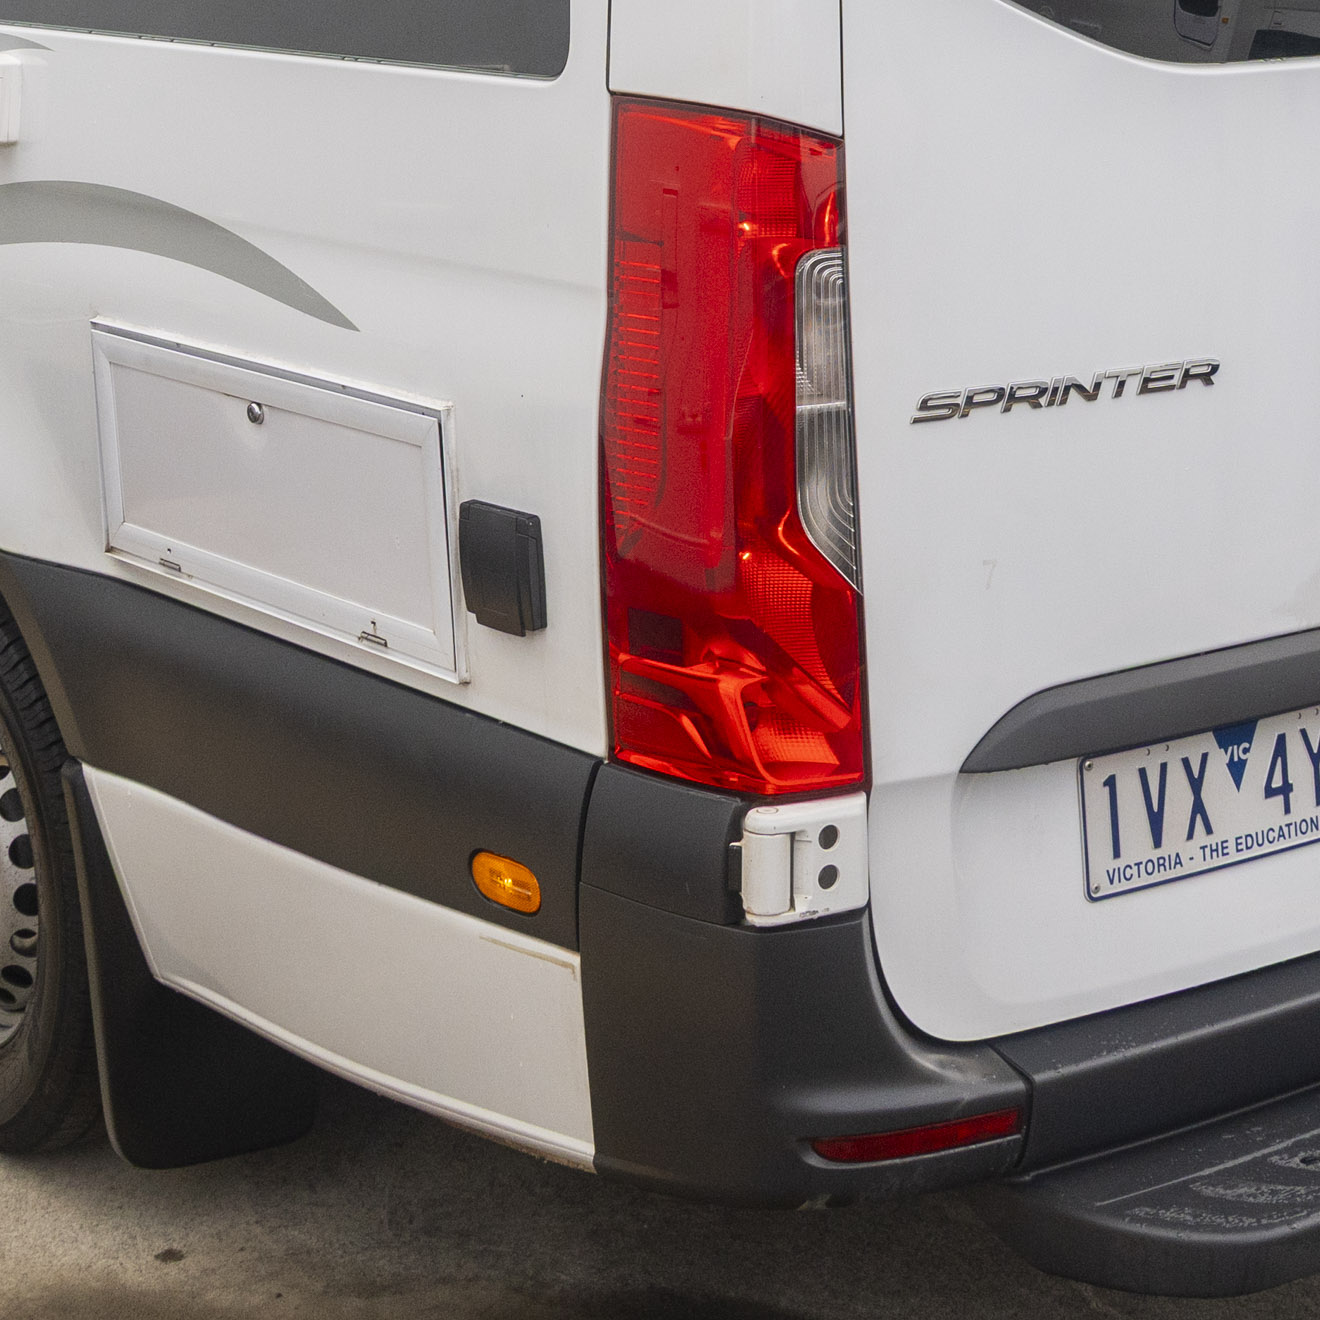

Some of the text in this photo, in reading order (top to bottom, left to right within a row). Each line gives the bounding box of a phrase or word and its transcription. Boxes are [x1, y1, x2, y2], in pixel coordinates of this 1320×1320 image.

[909, 356, 1221, 425] SPRINTER
[1222, 741, 1250, 763] VIC
[1102, 751, 1214, 860] 1VX
[1106, 852, 1184, 886] VICTORIA
[1199, 839, 1230, 862] THE
[1235, 816, 1320, 854] EDUCATION
